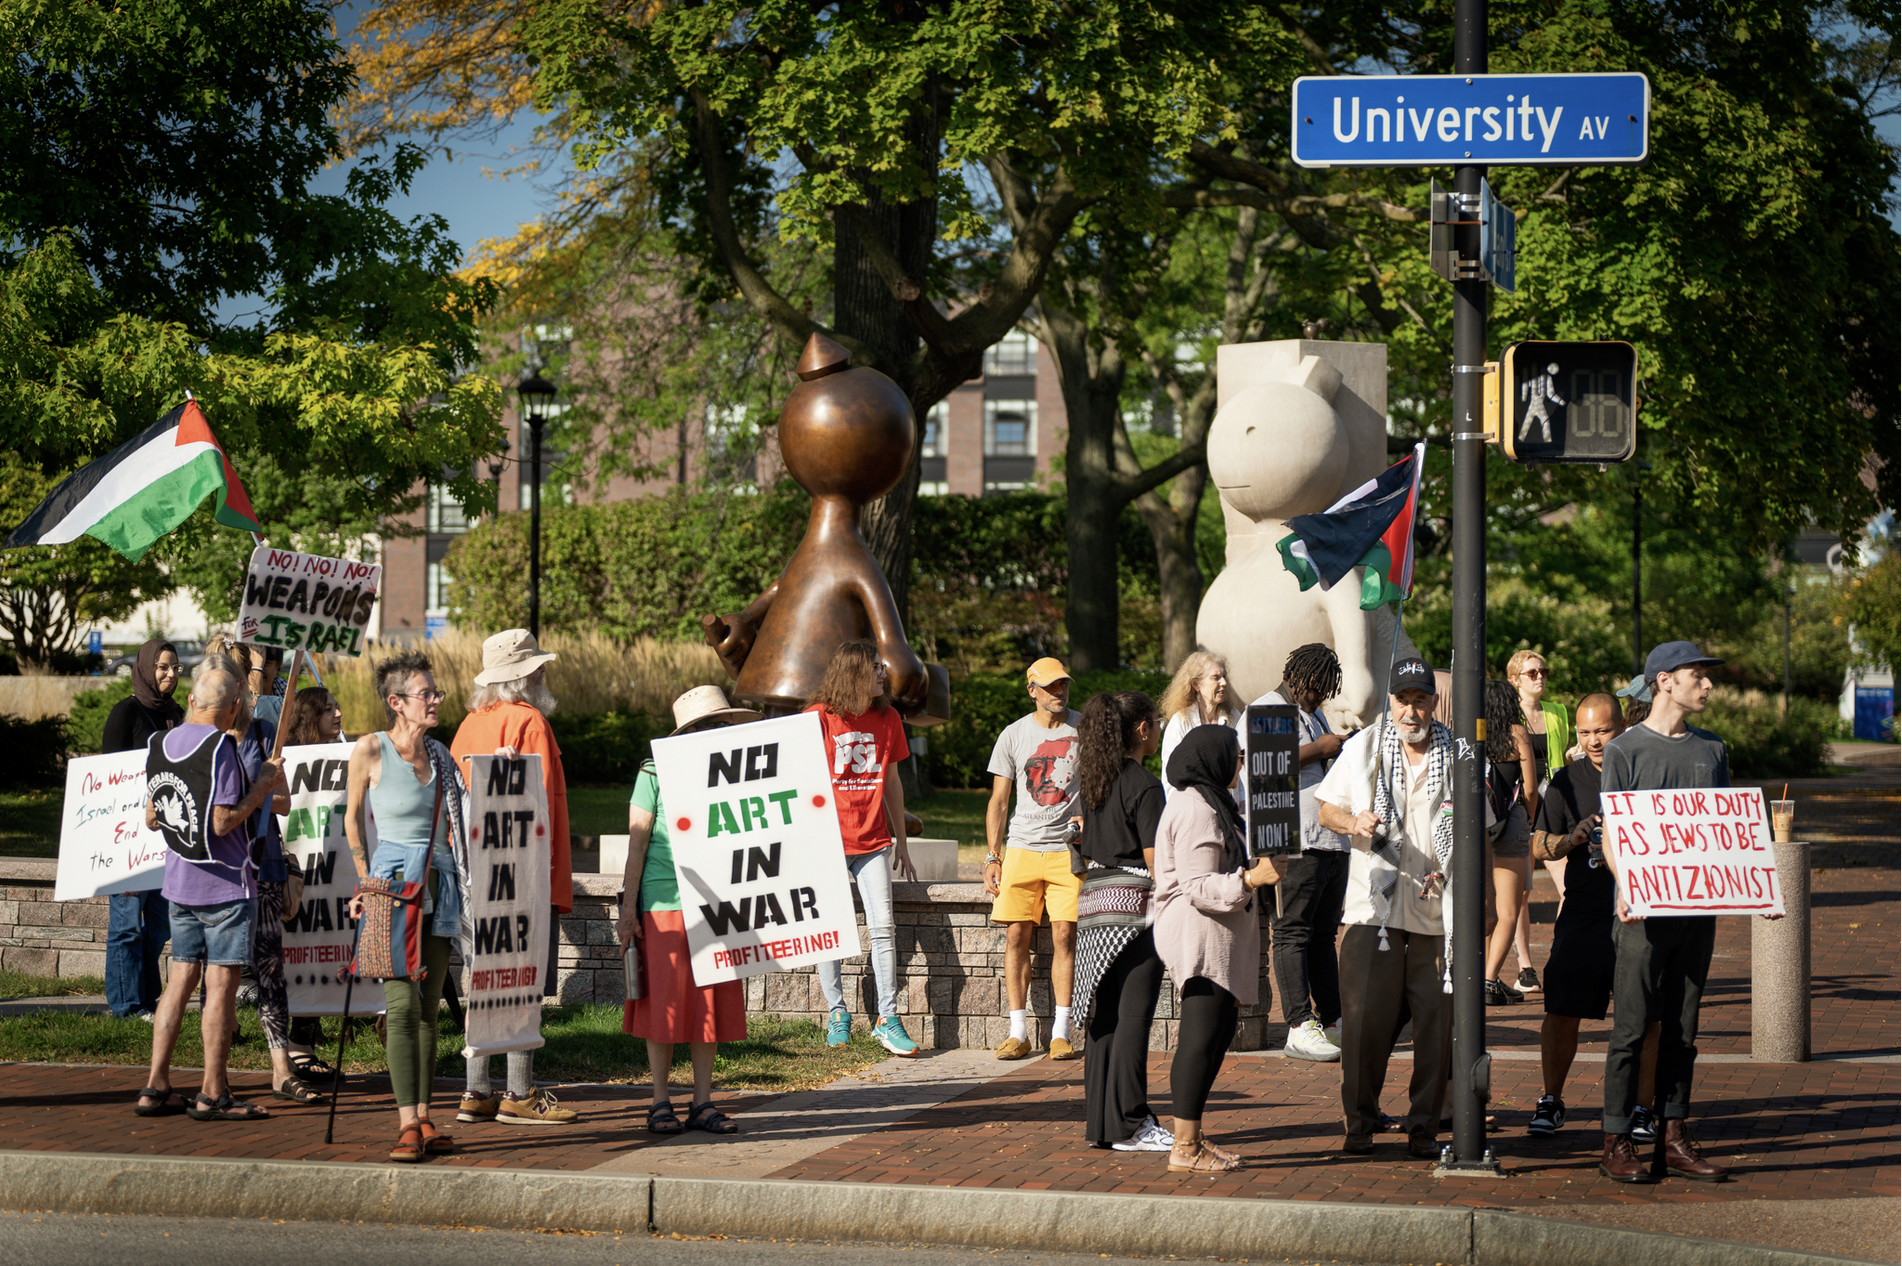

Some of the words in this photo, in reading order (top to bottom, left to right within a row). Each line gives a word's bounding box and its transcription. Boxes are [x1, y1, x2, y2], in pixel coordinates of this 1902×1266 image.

[1333, 94, 1564, 153] University
[1579, 116, 1610, 141] AV
[267, 550, 300, 573] NO!
[303, 557, 338, 578] NO!
[343, 563, 376, 580] NO!
[246, 573, 376, 626] WEAPONS
[254, 614, 362, 658] ISRAEL
[1250, 716, 1293, 735] SETTLERS
[291, 759, 349, 795] NO
[487, 758, 527, 796] NO
[707, 742, 779, 788] NO
[834, 743, 882, 774] PSL
[1252, 751, 1274, 776] OUT
[1277, 750, 1292, 775] OF
[82, 772, 102, 796] No
[148, 771, 174, 797] TERANS
[173, 776, 188, 796] FOR
[186, 792, 198, 833] PEACE
[1252, 791, 1295, 811] PALESTINE
[74, 798, 116, 829] Israel
[707, 789, 798, 838] ART
[1607, 792, 1635, 816] IT
[1651, 793, 1666, 816] IS
[1673, 791, 1710, 816] OUR
[1715, 792, 1762, 820] DUTY
[114, 821, 139, 844] End
[482, 811, 534, 849] ART
[1257, 822, 1289, 849] NOW!
[1618, 822, 1650, 857] AS
[1658, 822, 1708, 855] JEWS
[1708, 823, 1732, 850] TO
[1735, 822, 1765, 851] BE
[304, 851, 336, 886] IN
[731, 842, 782, 884] IN
[488, 863, 516, 902] IN
[1628, 864, 1776, 904] ANTIZIONIST
[699, 886, 820, 937] WAR
[474, 915, 529, 955] WAR
[714, 930, 840, 969] PROFITEERING!
